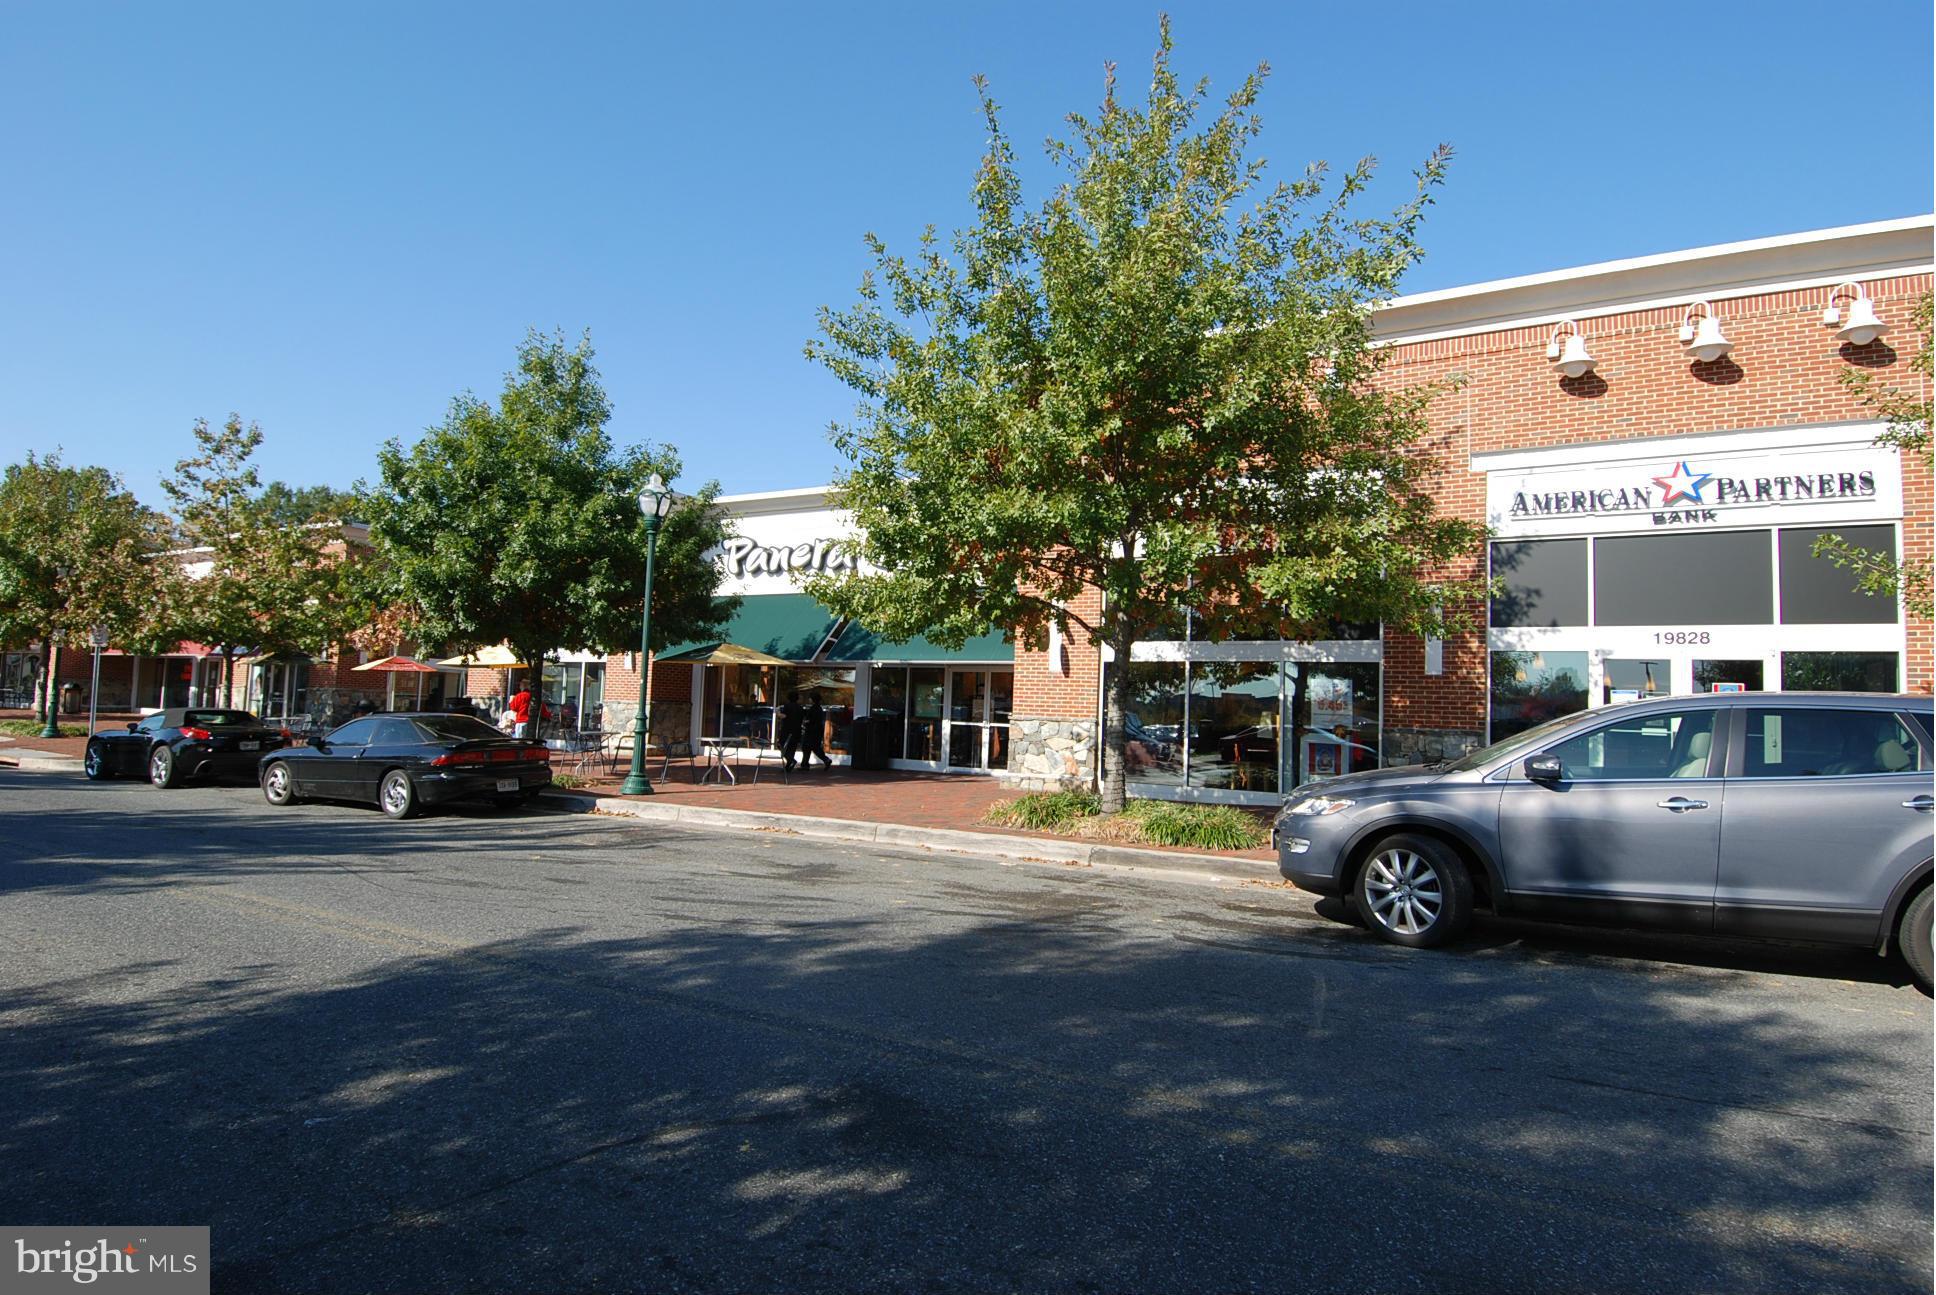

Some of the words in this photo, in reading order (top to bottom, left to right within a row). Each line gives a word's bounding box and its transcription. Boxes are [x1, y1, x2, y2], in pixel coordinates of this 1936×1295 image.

[1510, 486, 1652, 517] AMERICAN
[1716, 470, 1876, 504] PARTNERS
[1652, 508, 1718, 525] BANK
[1653, 631, 1711, 646] 19828
